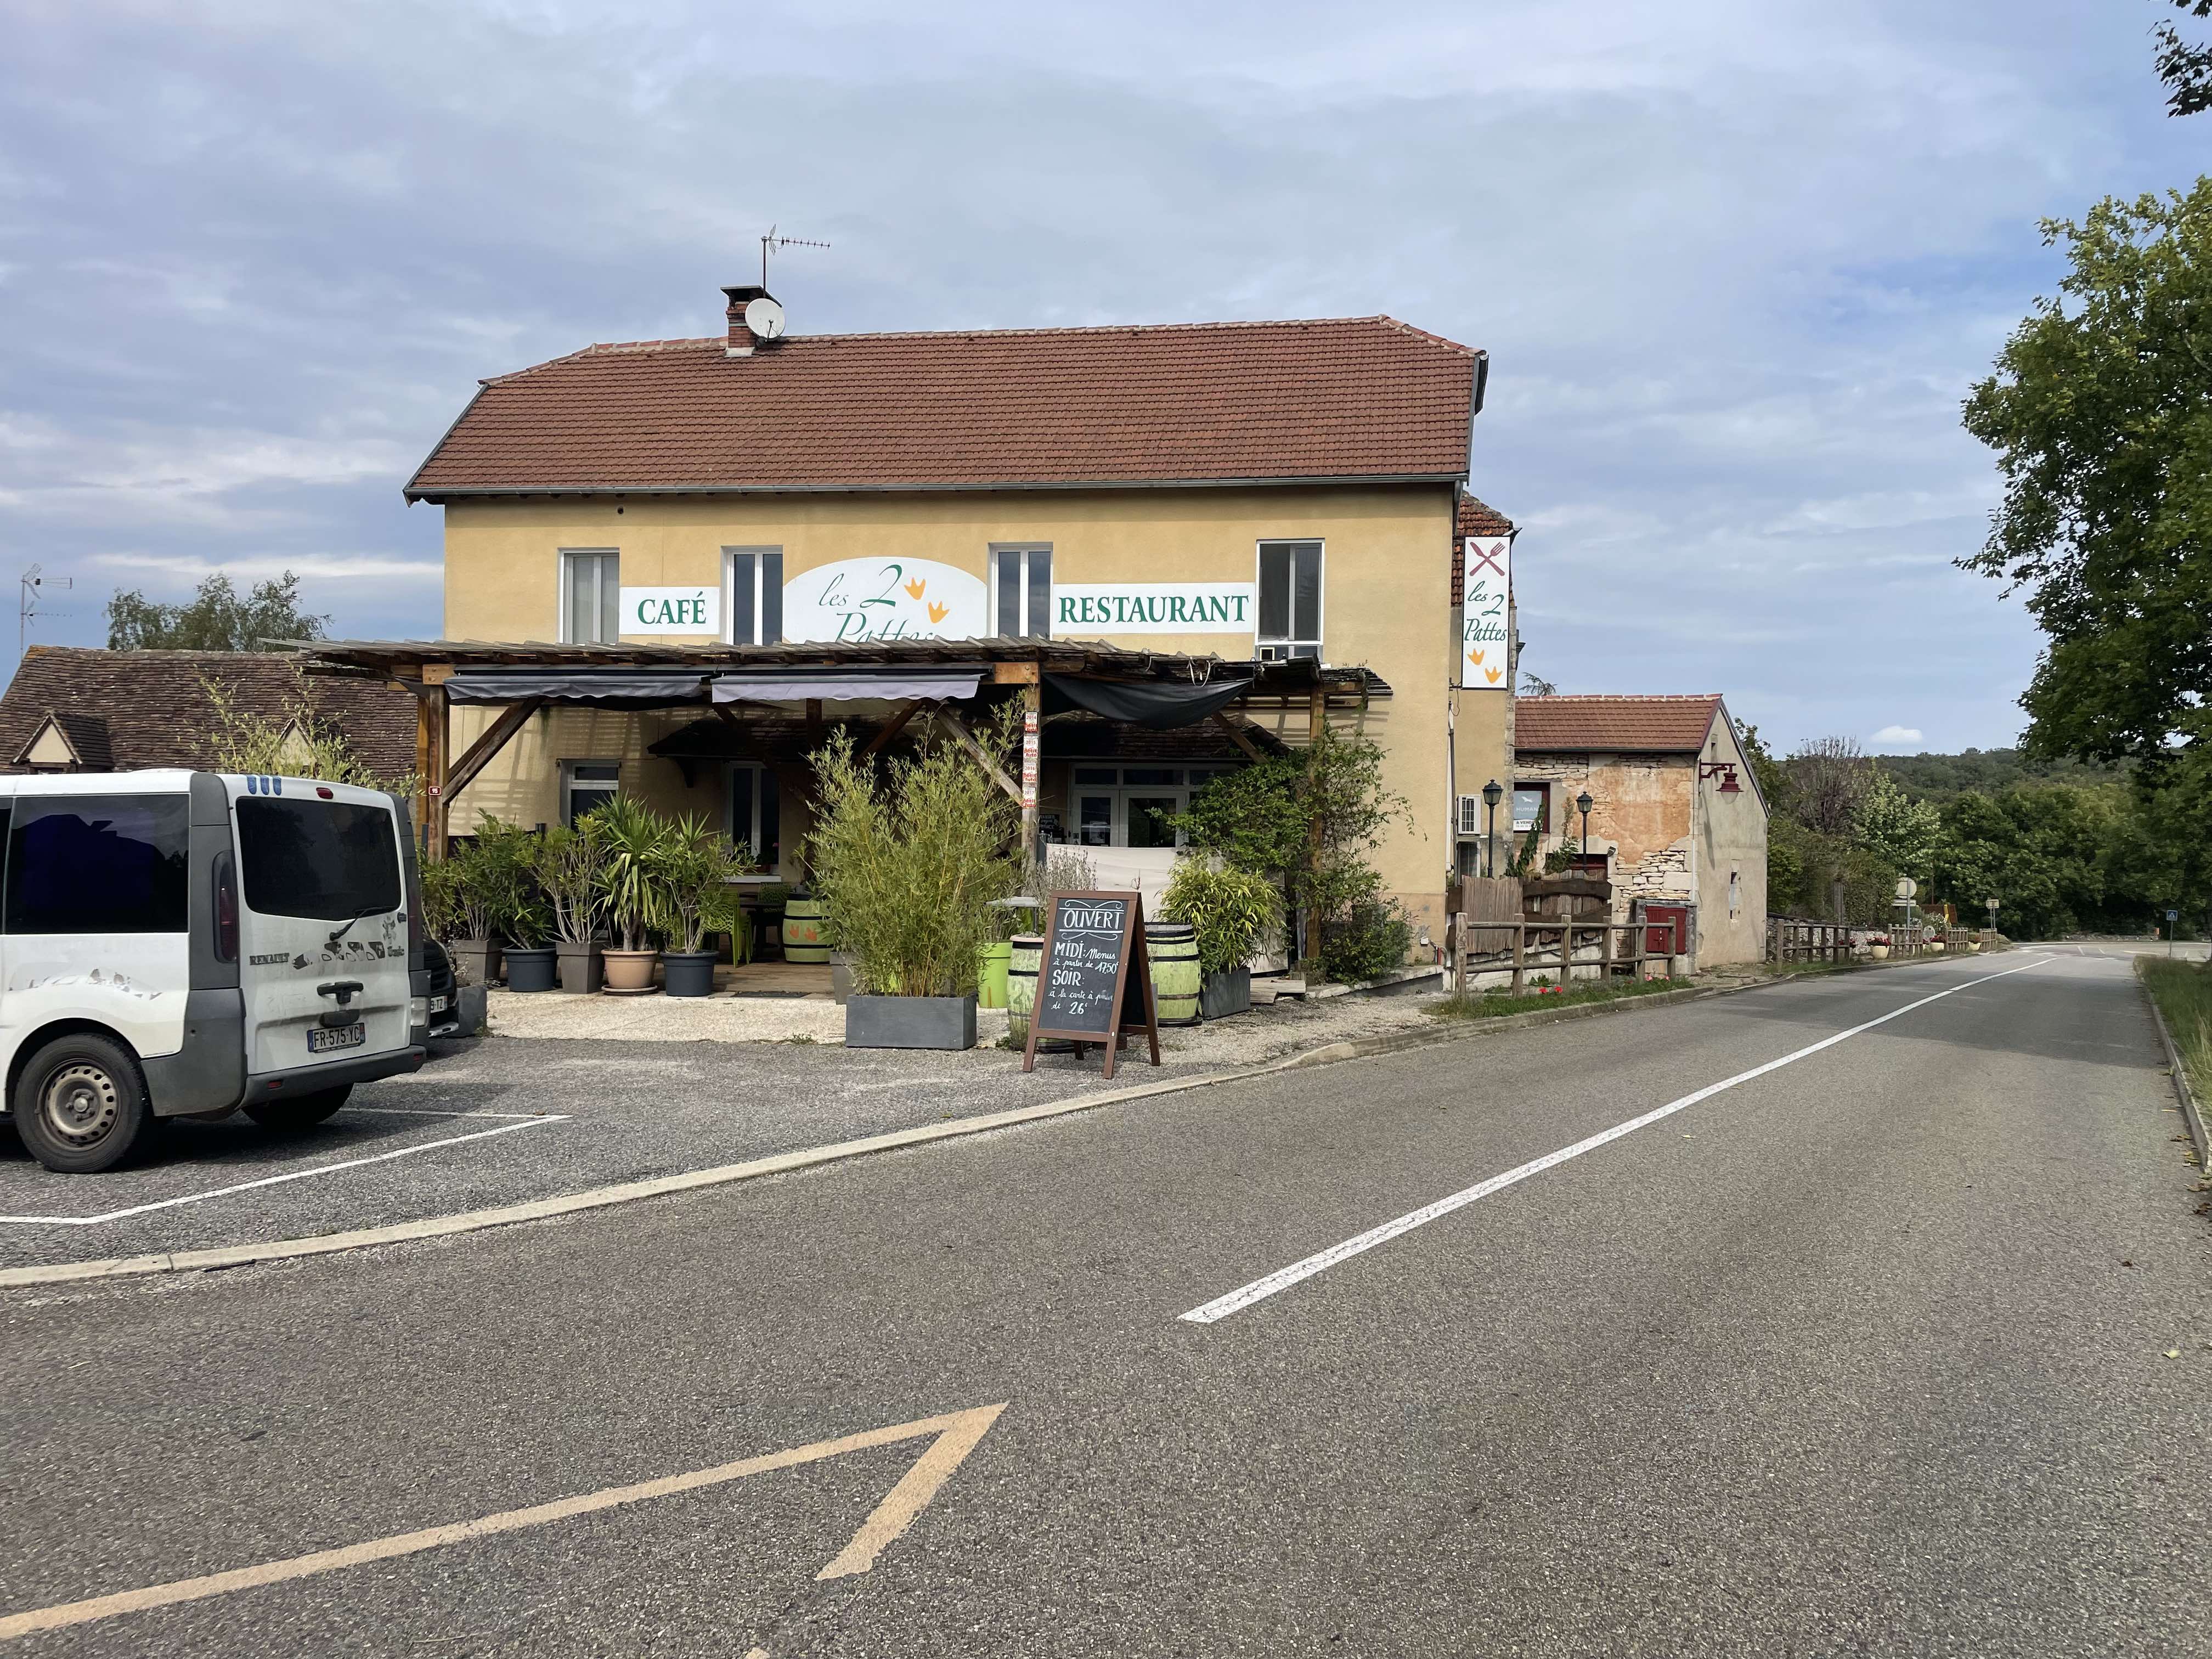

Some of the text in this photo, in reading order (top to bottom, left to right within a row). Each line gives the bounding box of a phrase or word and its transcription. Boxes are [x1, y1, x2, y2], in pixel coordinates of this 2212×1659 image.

[819, 564, 902, 608] les 2
[637, 591, 707, 624] CAFÉ
[1058, 595, 1249, 623] RESTAURANT
[1468, 580, 1504, 616] les 2
[1464, 618, 1507, 642] Pattes
[1064, 910, 1124, 929] OUVERT
[1085, 948, 1116, 960] Menus
[1048, 987, 1056, 998] à
[1058, 988, 1067, 997] la
[1069, 990, 1086, 999] carte
[1087, 990, 1093, 1000] à
[1051, 1001, 1061, 1009] de
[313, 1026, 360, 1048] FR-575-YC
